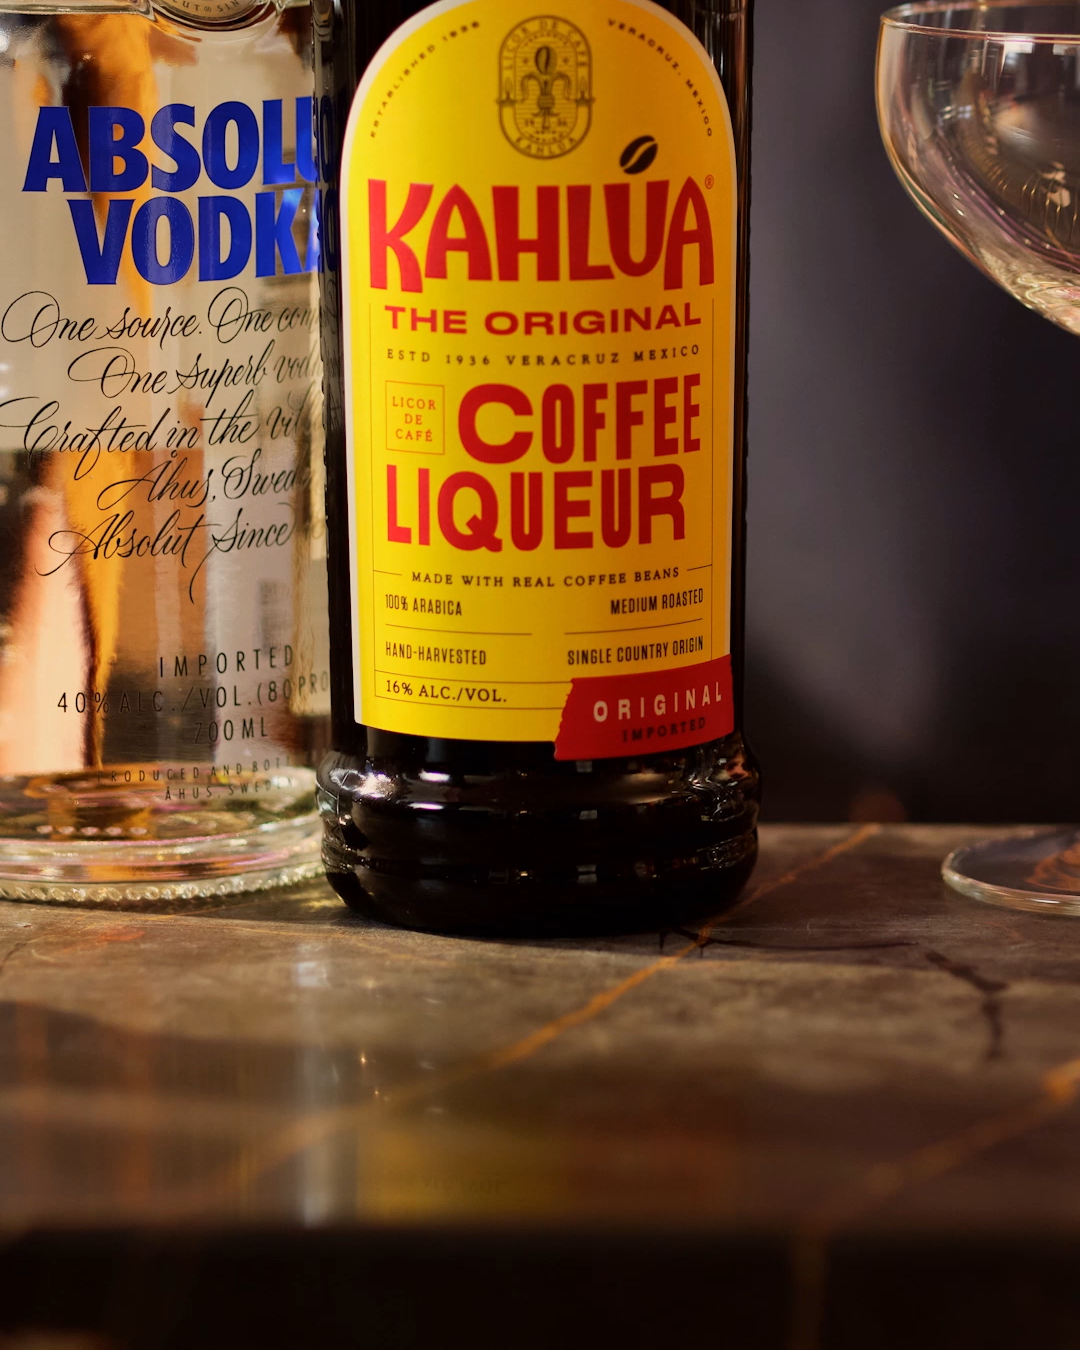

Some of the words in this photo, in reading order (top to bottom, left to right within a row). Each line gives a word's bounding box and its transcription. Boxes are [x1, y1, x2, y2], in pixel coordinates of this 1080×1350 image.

[370, 44, 436, 138] ESTABLISHED
[685, 78, 713, 138] MEXICO
[1, 290, 99, 348] One
[96, 306, 203, 351] source.
[208, 286, 274, 344] One
[384, 304, 468, 335] THE
[485, 301, 702, 337] ORIGINAL
[386, 347, 431, 364] ESTD
[445, 352, 492, 367] 1936
[506, 351, 620, 367] VERACRUZ
[633, 343, 700, 363] MEXICO
[67, 346, 168, 399] One
[168, 339, 276, 408] superb
[390, 394, 438, 412] LICOR
[457, 373, 701, 464] COFFEE
[0, 395, 171, 481] Crafted
[166, 420, 201, 452] in
[200, 389, 262, 446] the
[394, 426, 434, 443] CAFÉ
[404, 413, 424, 427] DE
[96, 450, 217, 511] Åhus,
[386, 463, 686, 553] LIQUEUR
[34, 509, 222, 577] Absolut
[411, 569, 454, 586] MADE
[461, 574, 506, 588] WITH
[512, 573, 556, 588] REAL
[562, 572, 627, 588] COFFEE
[634, 565, 681, 583] BEANS
[385, 593, 409, 612] 100%
[412, 596, 463, 617] ARABICA
[610, 594, 658, 616] MEDIUM
[661, 587, 704, 609] ROASTED
[159, 644, 294, 678] IMPORTED
[385, 640, 487, 666] HAND-HARVESTED
[567, 648, 612, 666] SINGLE
[616, 641, 669, 663] COUNTRY
[672, 635, 704, 656] ORIGIN
[385, 678, 414, 697] 16%
[417, 681, 508, 704] ALC./VOL.
[593, 681, 722, 723] ORIGINAL
[622, 716, 706, 743] IMPORTED
[97, 765, 199, 783] PRODUCED
[210, 762, 243, 777] AND
